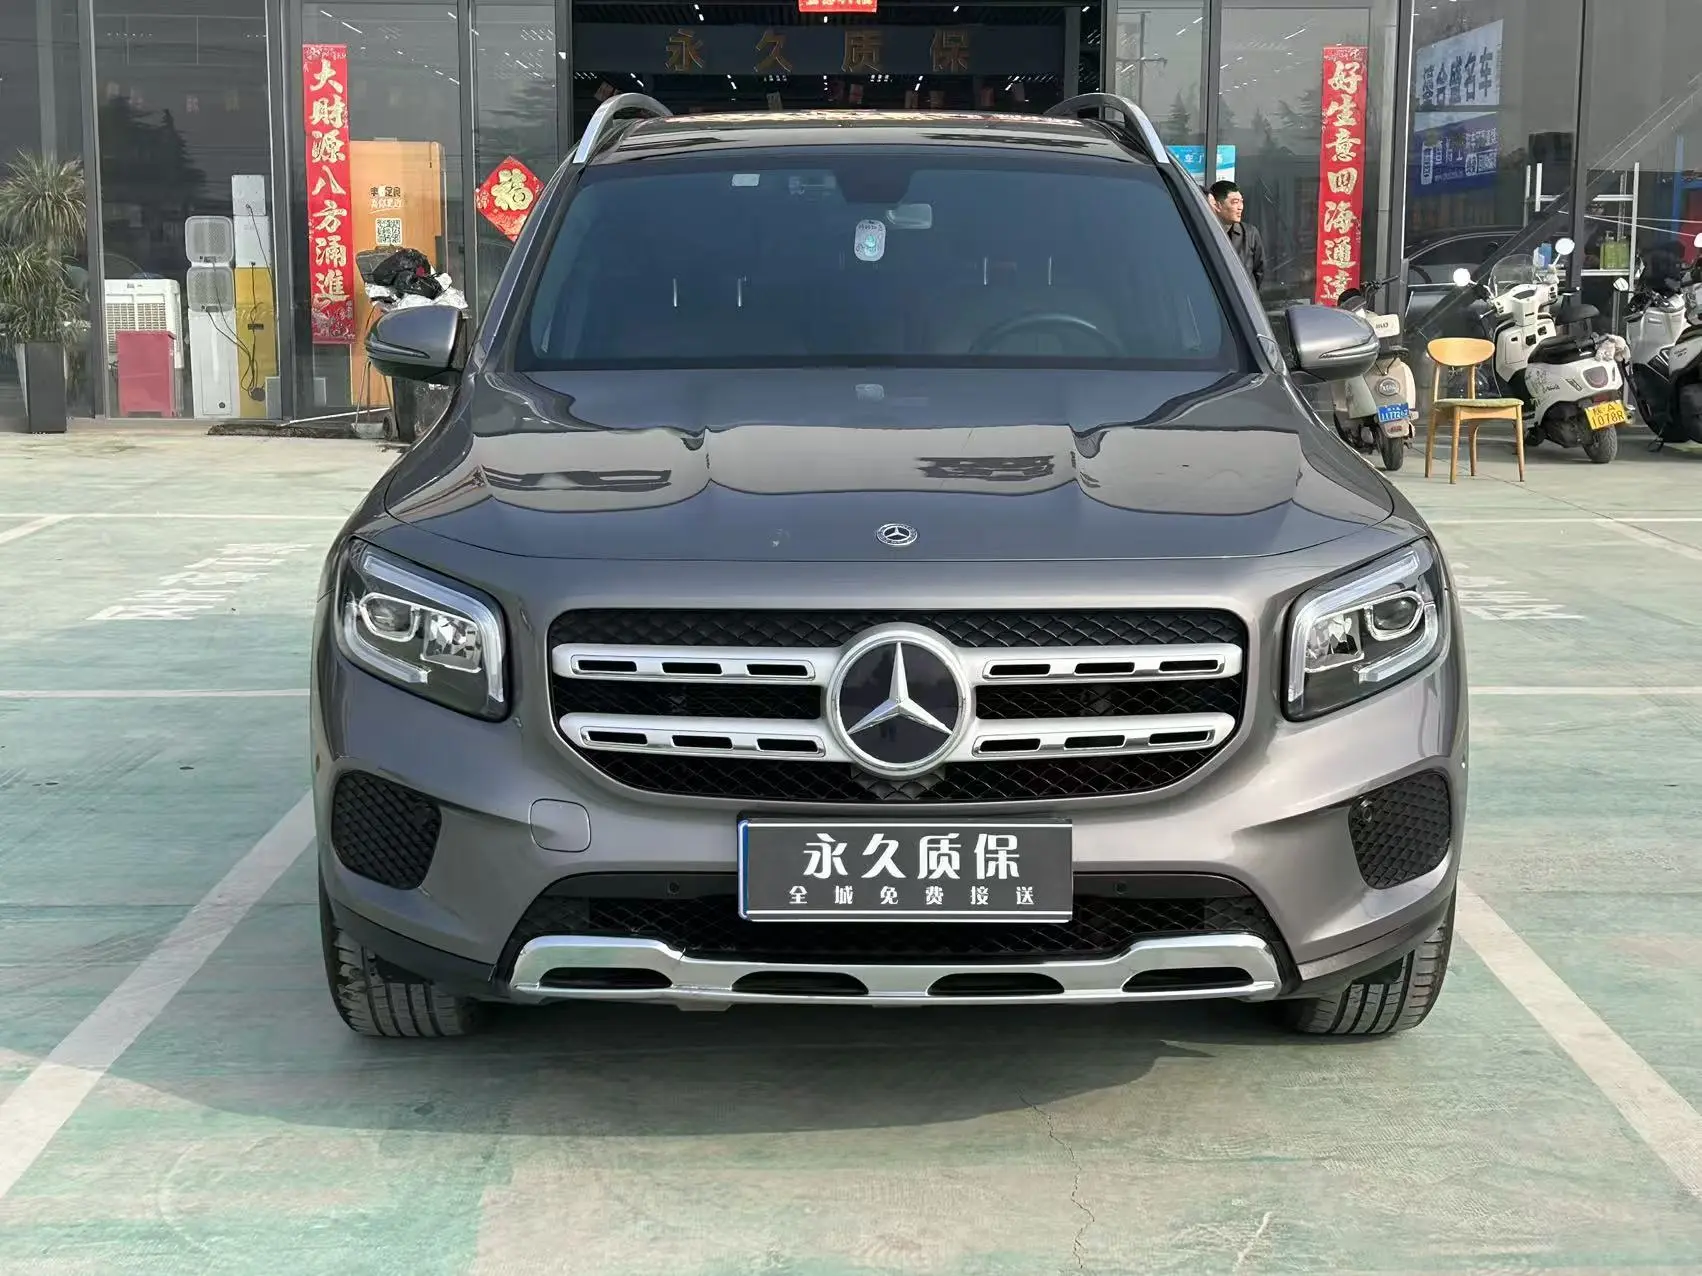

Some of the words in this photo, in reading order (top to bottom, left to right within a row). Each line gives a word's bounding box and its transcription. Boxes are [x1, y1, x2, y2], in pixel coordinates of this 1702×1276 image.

[665, 28, 970, 73] 永久质保
[490, 168, 534, 212] 福
[1591, 410, 1625, 428] 1078R
[803, 833, 1020, 880] 永久质保
[788, 885, 1035, 905] 全城免费接送
